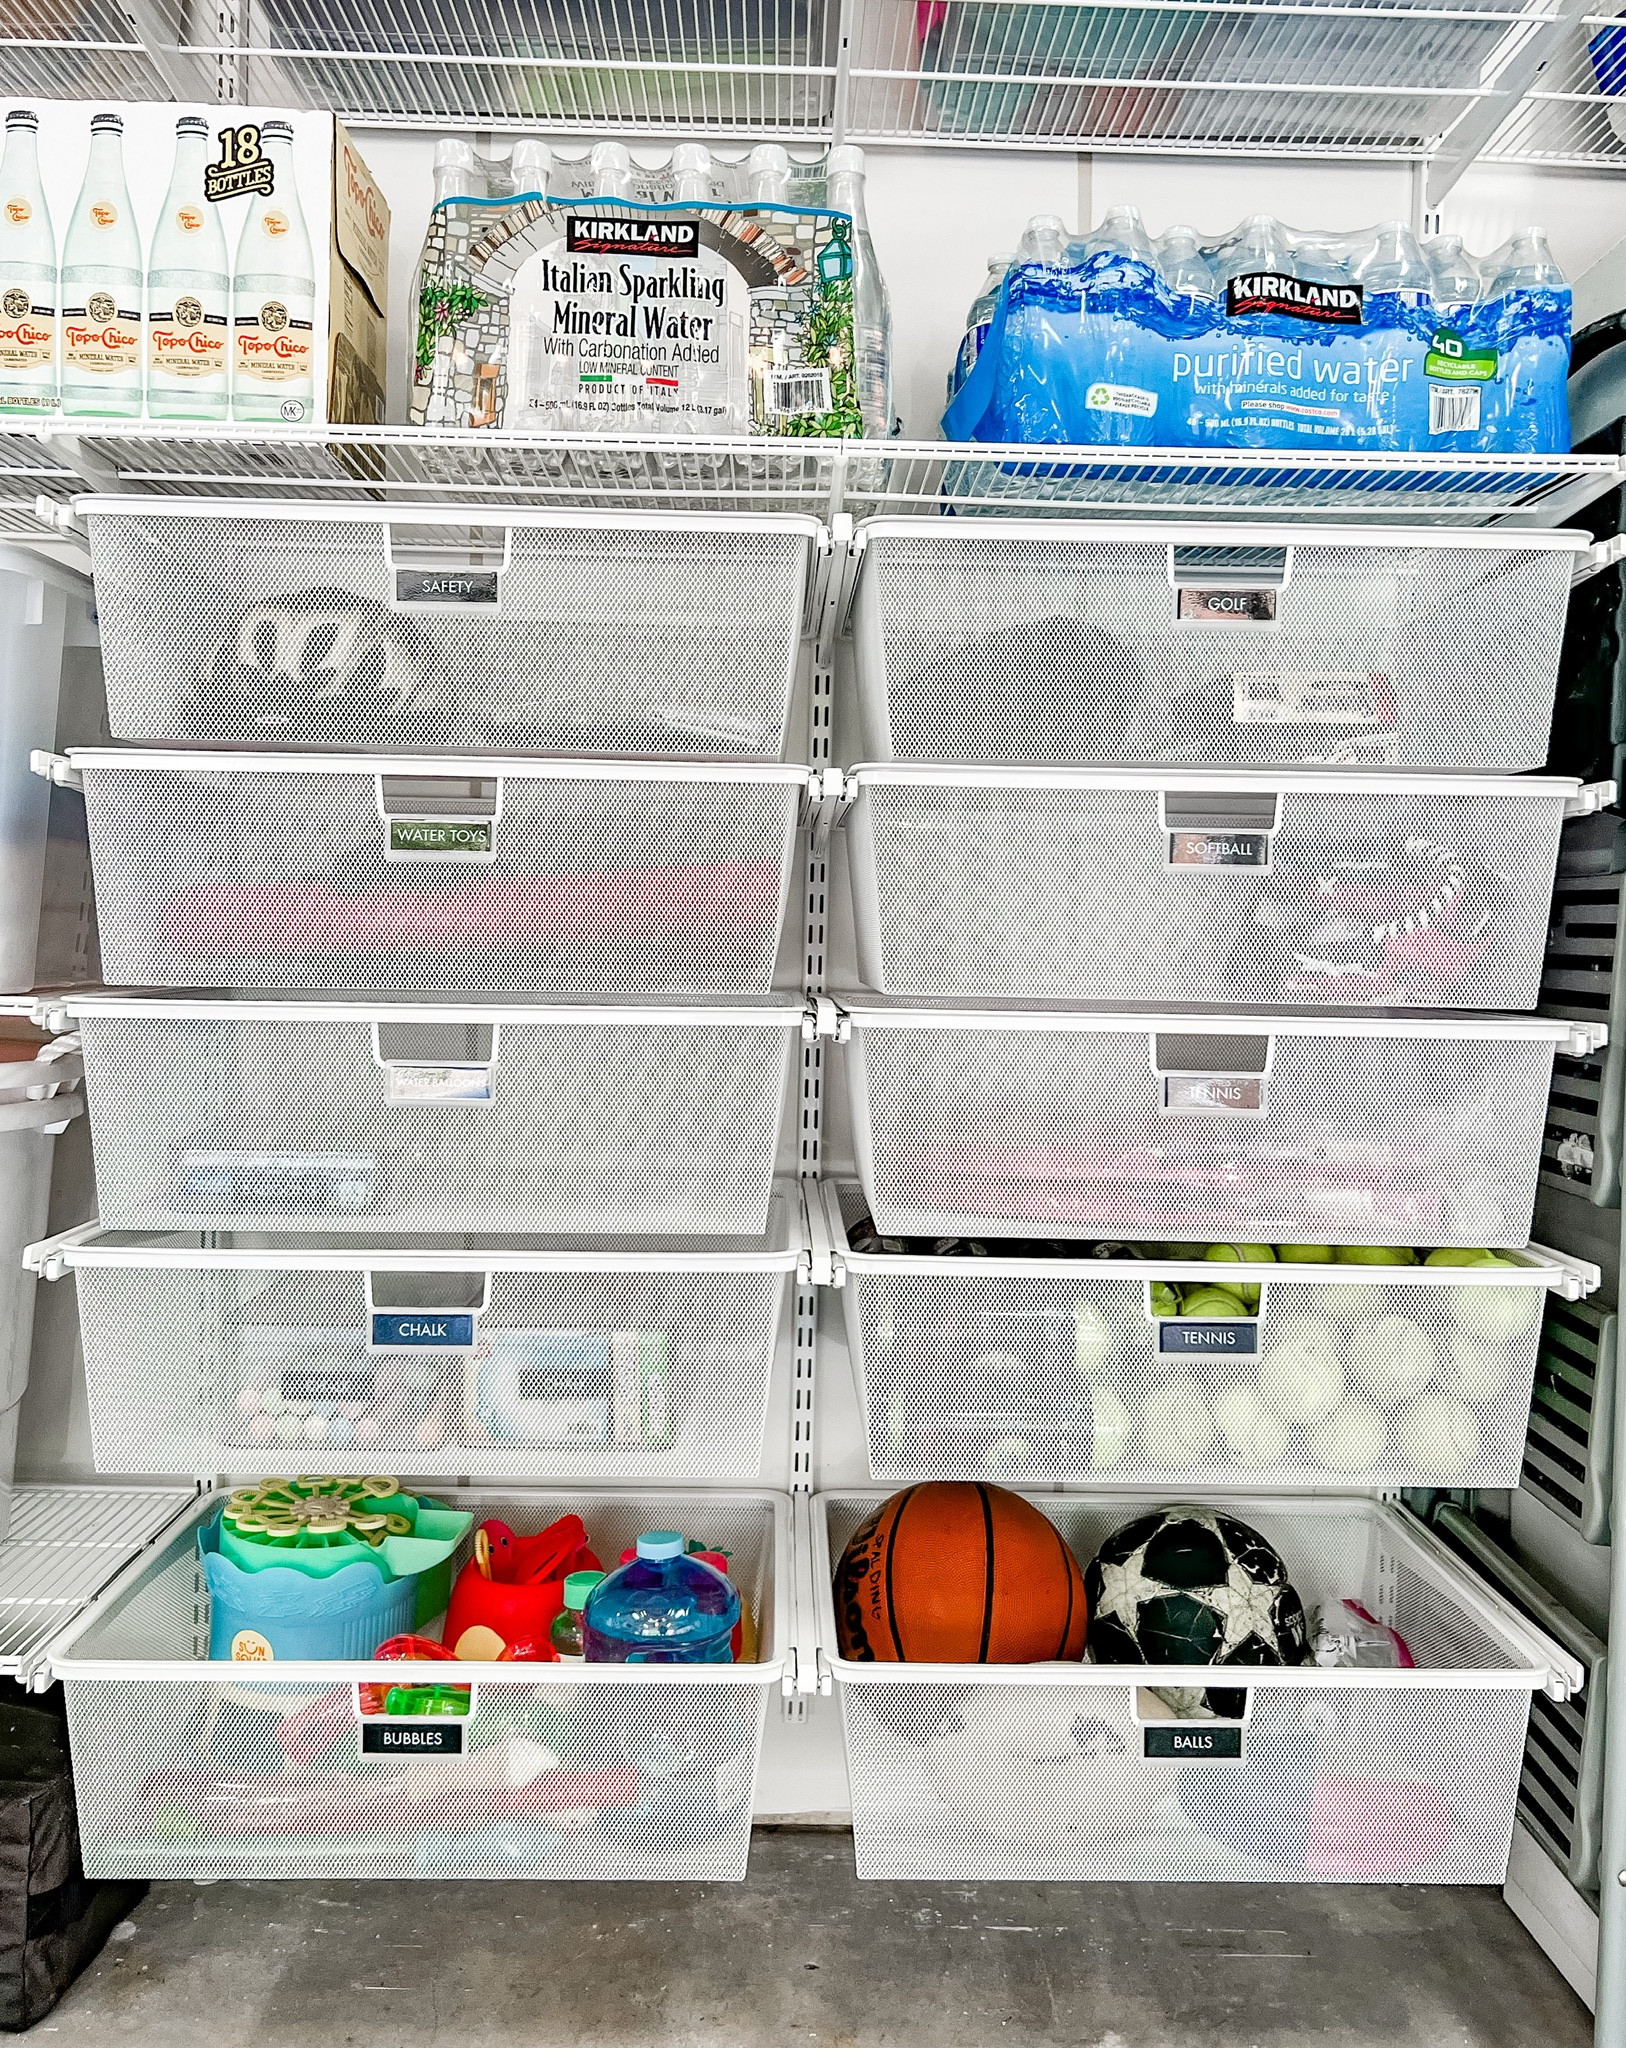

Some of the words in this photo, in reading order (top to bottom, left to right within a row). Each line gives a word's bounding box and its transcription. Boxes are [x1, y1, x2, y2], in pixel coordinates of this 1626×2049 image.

[220, 126, 260, 169] 18
[207, 165, 272, 194] BOTTLES
[574, 220, 695, 243] KIRKLAND
[573, 238, 694, 256] Signature
[541, 258, 613, 293] Italian
[619, 263, 725, 308] Sparkling
[1233, 275, 1359, 308] KIRKLAND
[1233, 295, 1357, 318] Signature
[551, 300, 637, 338] Mineral
[642, 305, 714, 341] Water
[15, 322, 53, 346] Chico
[65, 325, 103, 347] Topo
[101, 326, 139, 350] Chico
[151, 329, 189, 351] Topo
[187, 331, 225, 354] Chico
[237, 335, 274, 356] Topo
[273, 335, 310, 359] Chico
[543, 337, 574, 357] With
[578, 337, 667, 362] Carbonation
[1431, 334, 1464, 359] 40
[579, 361, 598, 374] LOW
[599, 361, 638, 376] MINERAL
[640, 364, 680, 378] CONTENT
[1172, 342, 1303, 383] purified
[1313, 355, 1415, 385] water
[578, 383, 626, 395] PRODUCT
[631, 385, 644, 395] OF
[650, 385, 680, 398] ITALY
[1194, 380, 1227, 396] with
[1289, 385, 1328, 402] added
[1329, 387, 1350, 402] for
[1268, 402, 1285, 411] shop
[1285, 404, 1338, 416] www.costco.com
[421, 579, 474, 593] SAFETY
[1207, 597, 1248, 611] GOLF
[396, 828, 446, 842] WATER
[449, 829, 487, 843] TOYS
[1185, 841, 1253, 856] SOFTBALL
[1187, 1086, 1241, 1100] TENNIS
[398, 1322, 448, 1337] CHALK
[1181, 1331, 1236, 1345] TENNIS
[868, 1533, 885, 1621] SPALDING
[383, 1732, 443, 1746] BUBBLES
[1173, 1735, 1214, 1749] BALLS
